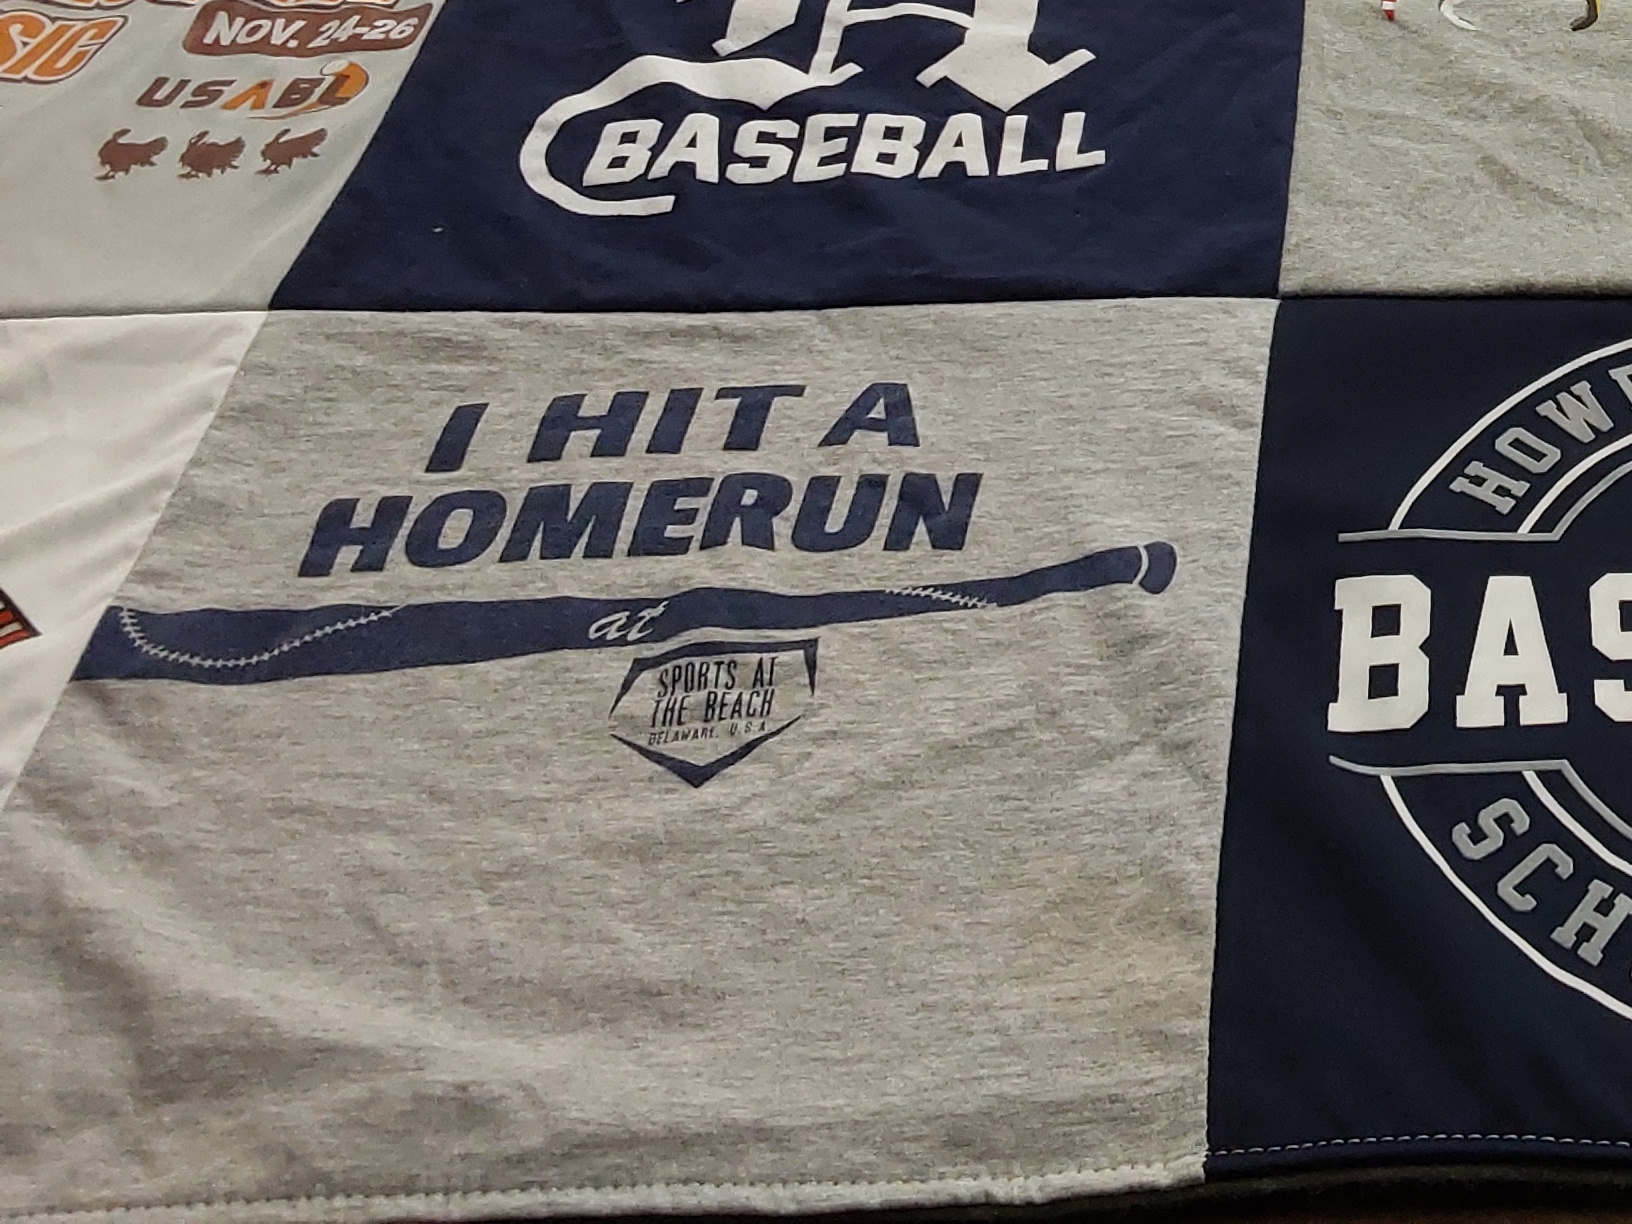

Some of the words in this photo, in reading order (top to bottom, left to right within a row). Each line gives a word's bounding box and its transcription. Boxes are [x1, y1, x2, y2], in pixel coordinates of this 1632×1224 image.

[202, 12, 298, 49] NOV.
[306, 16, 419, 50] 24-26
[136, 60, 370, 120] USABL
[582, 111, 1107, 188] BASEBALL
[424, 403, 488, 474] I
[527, 383, 805, 464] HIT
[818, 382, 922, 449] A
[298, 471, 983, 577] HOMERUN
[587, 600, 671, 643] at
[657, 659, 739, 699] SPORTS
[752, 656, 779, 688] AT
[650, 694, 691, 728] THE
[703, 688, 776, 723] BEACH
